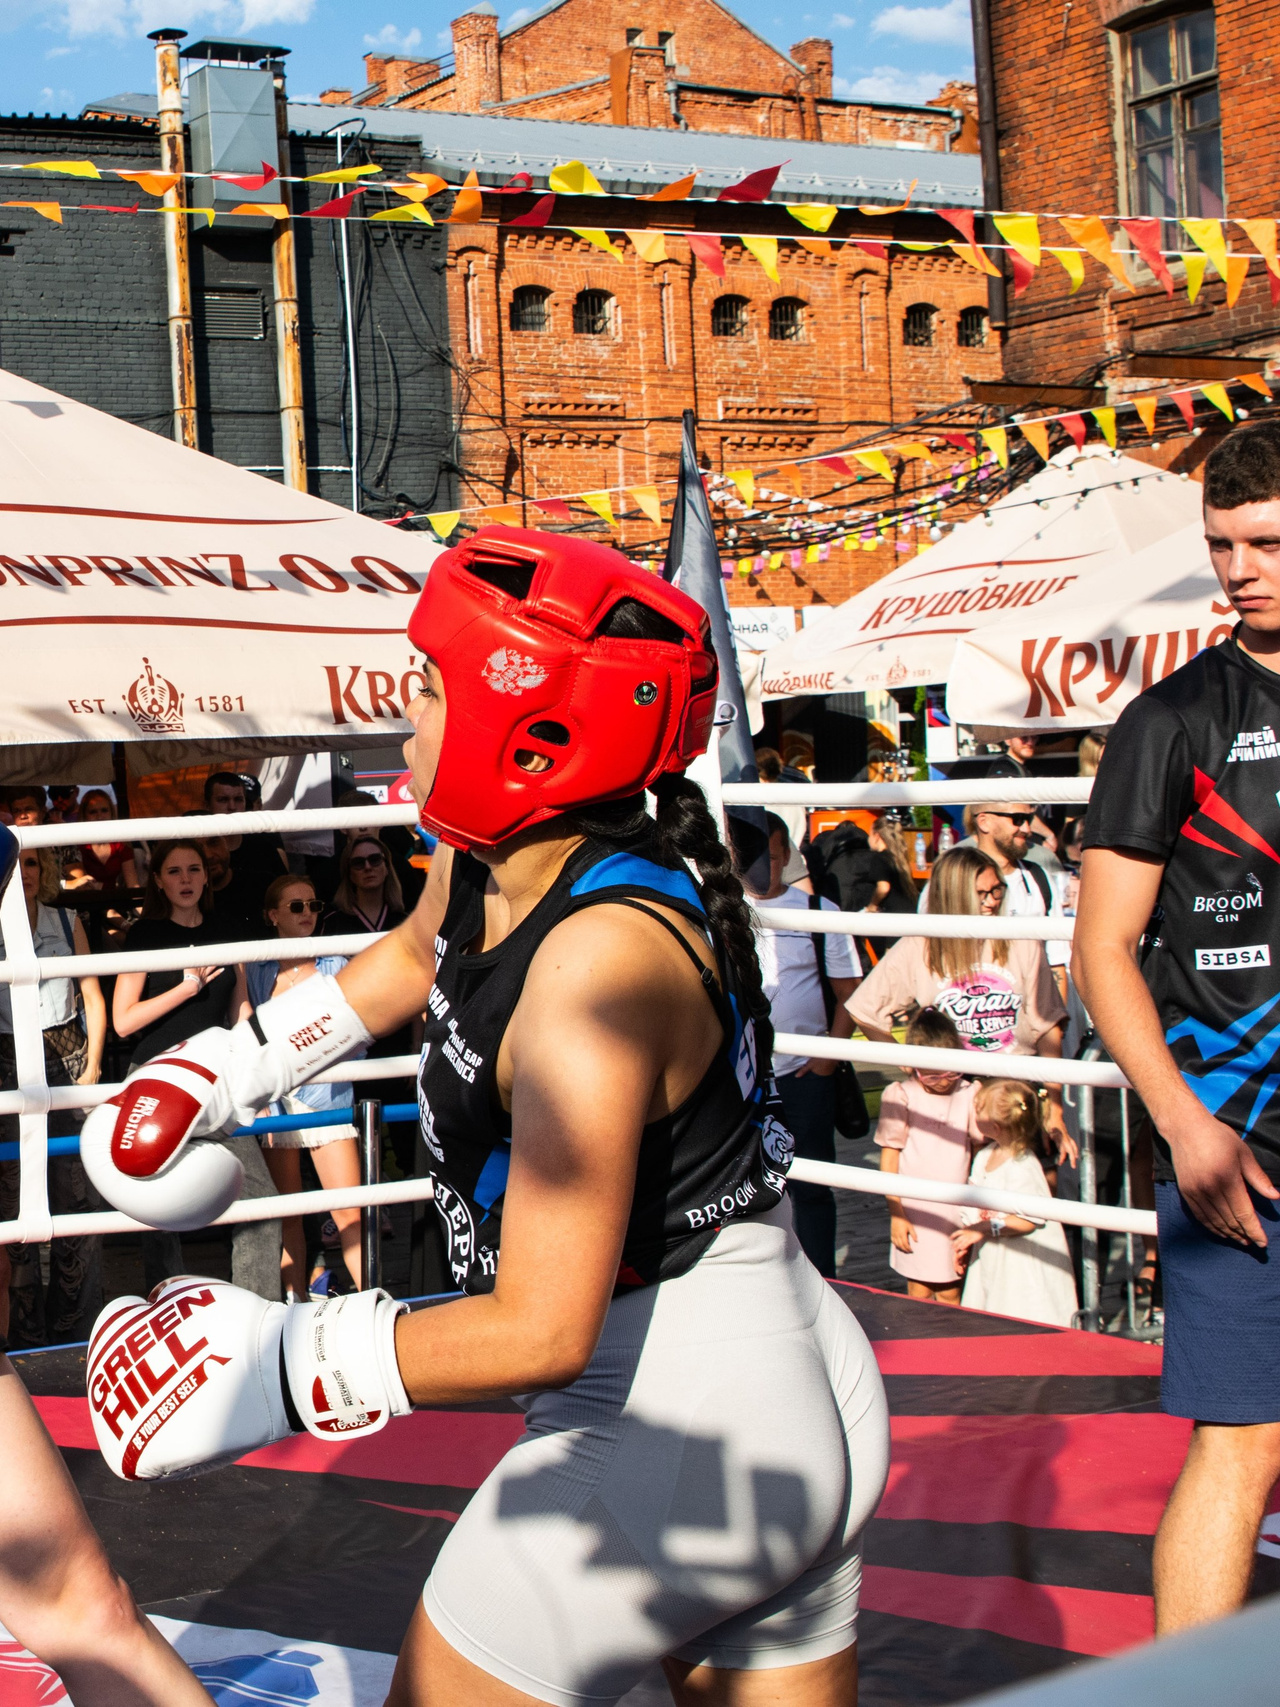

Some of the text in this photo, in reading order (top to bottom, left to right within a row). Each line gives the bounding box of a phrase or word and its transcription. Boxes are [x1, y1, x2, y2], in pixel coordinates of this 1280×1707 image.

[278, 553, 423, 595] 0.0
[68, 695, 246, 716] EST. 1581
[1232, 725, 1276, 749] ДРЕЙ
[1193, 891, 1263, 912] BROOM
[1215, 913, 1239, 923] GIN
[1200, 950, 1265, 966] SIBSA
[295, 1027, 333, 1052] HILL
[684, 1174, 758, 1230] BROOM
[91, 1288, 217, 1413] GREEN
[101, 1330, 210, 1442] HILL
[132, 1373, 199, 1451] BE YOUR BEST SELF
